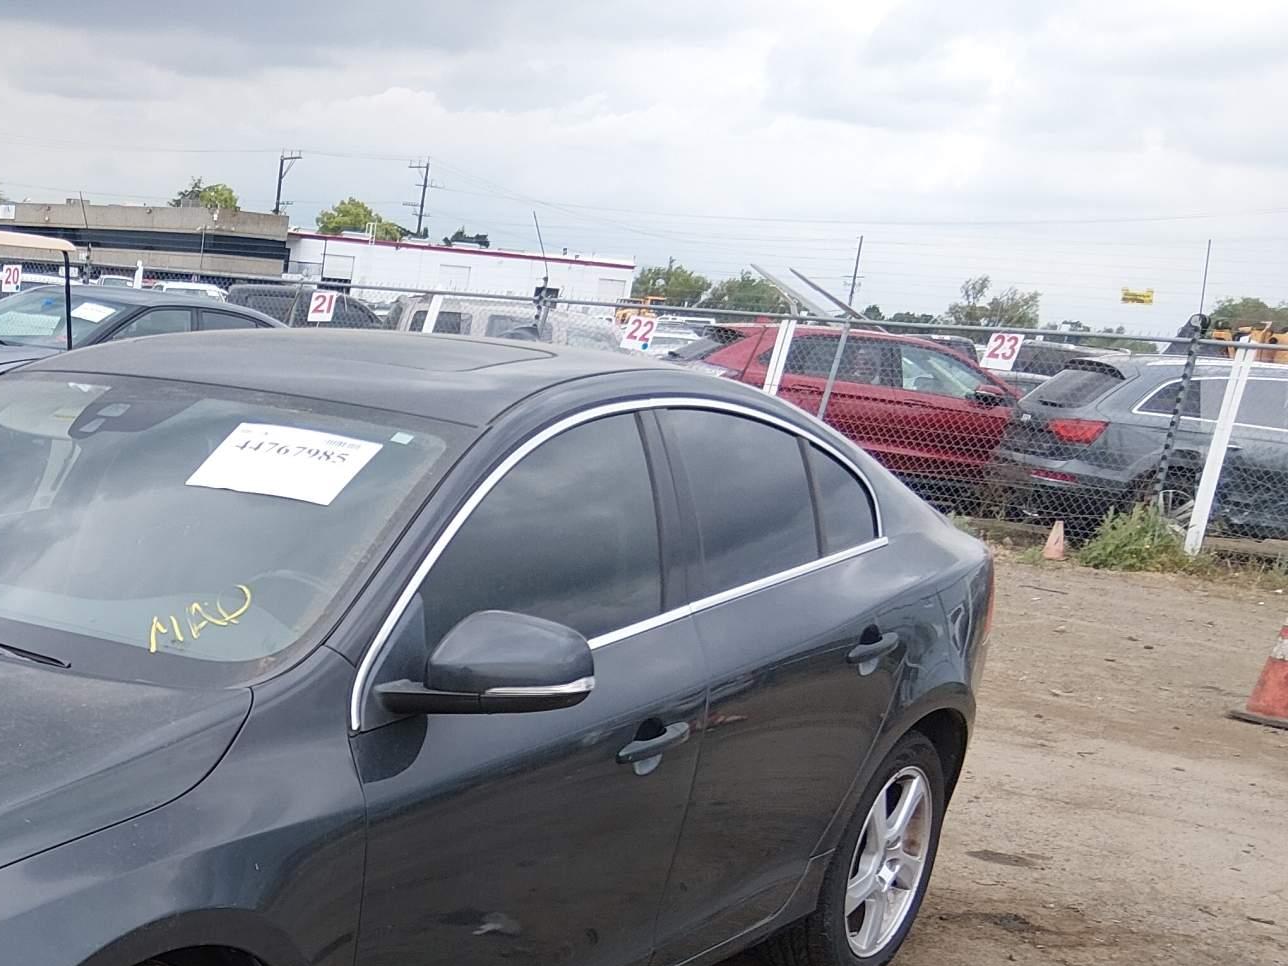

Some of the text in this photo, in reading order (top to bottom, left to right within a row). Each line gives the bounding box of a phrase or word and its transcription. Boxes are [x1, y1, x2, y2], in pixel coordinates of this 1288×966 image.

[4, 267, 20, 285] 20
[311, 294, 334, 314] 21
[626, 318, 655, 343] 22
[986, 334, 1019, 360] 23
[235, 439, 350, 465] 44767985
